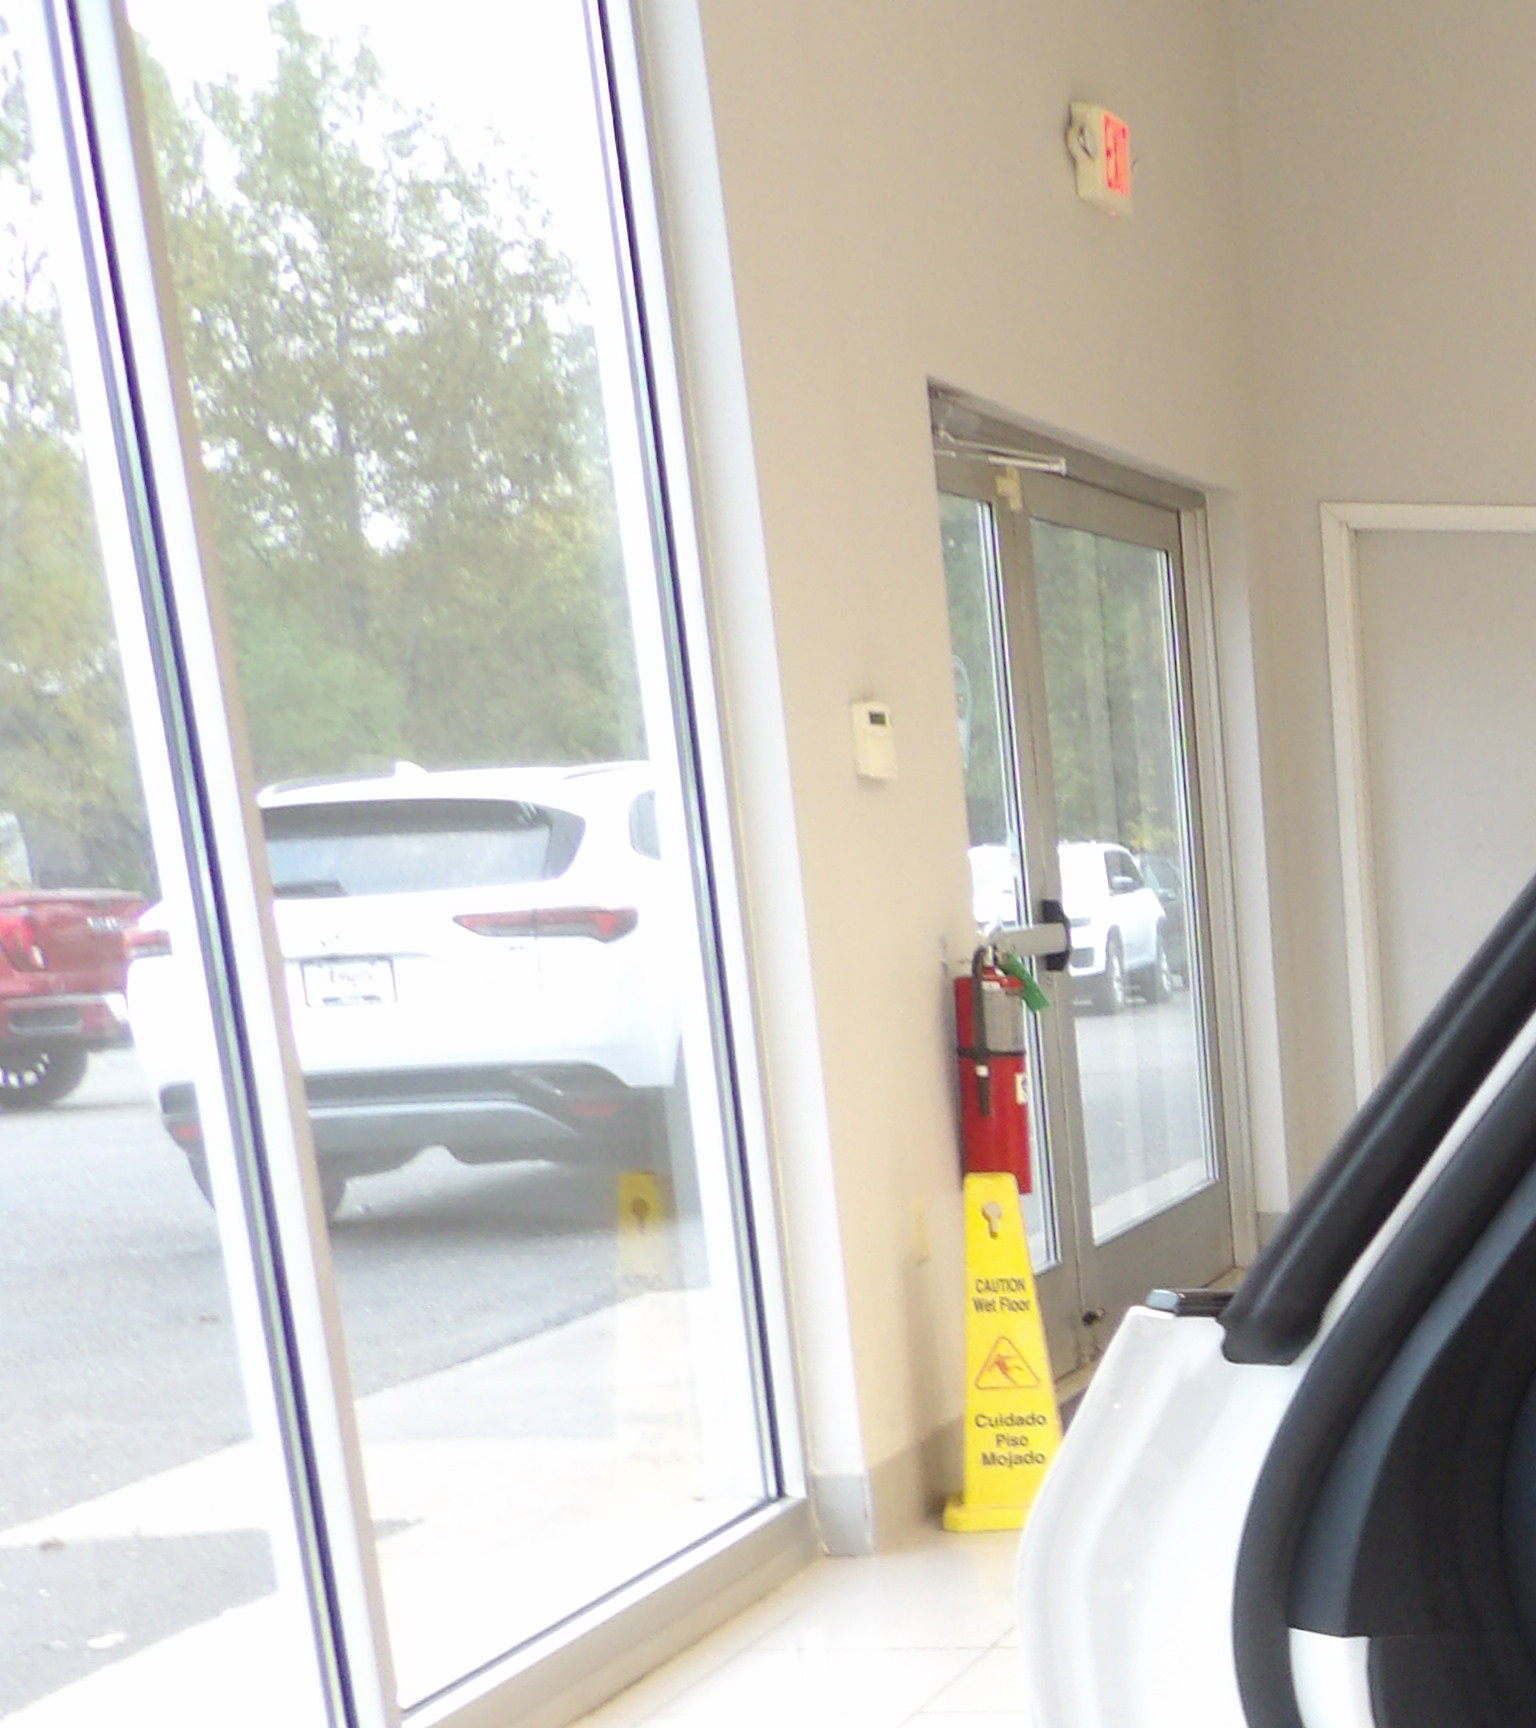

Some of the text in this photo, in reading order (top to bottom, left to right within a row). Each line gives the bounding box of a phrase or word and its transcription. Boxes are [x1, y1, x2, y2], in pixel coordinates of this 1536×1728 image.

[975, 1278, 1026, 1294] CAUTION
[973, 1298, 1031, 1312] Wet Floor
[974, 1413, 1047, 1428] Cuidado
[995, 1433, 1029, 1447] Piso
[982, 1452, 1046, 1468] Mojado
